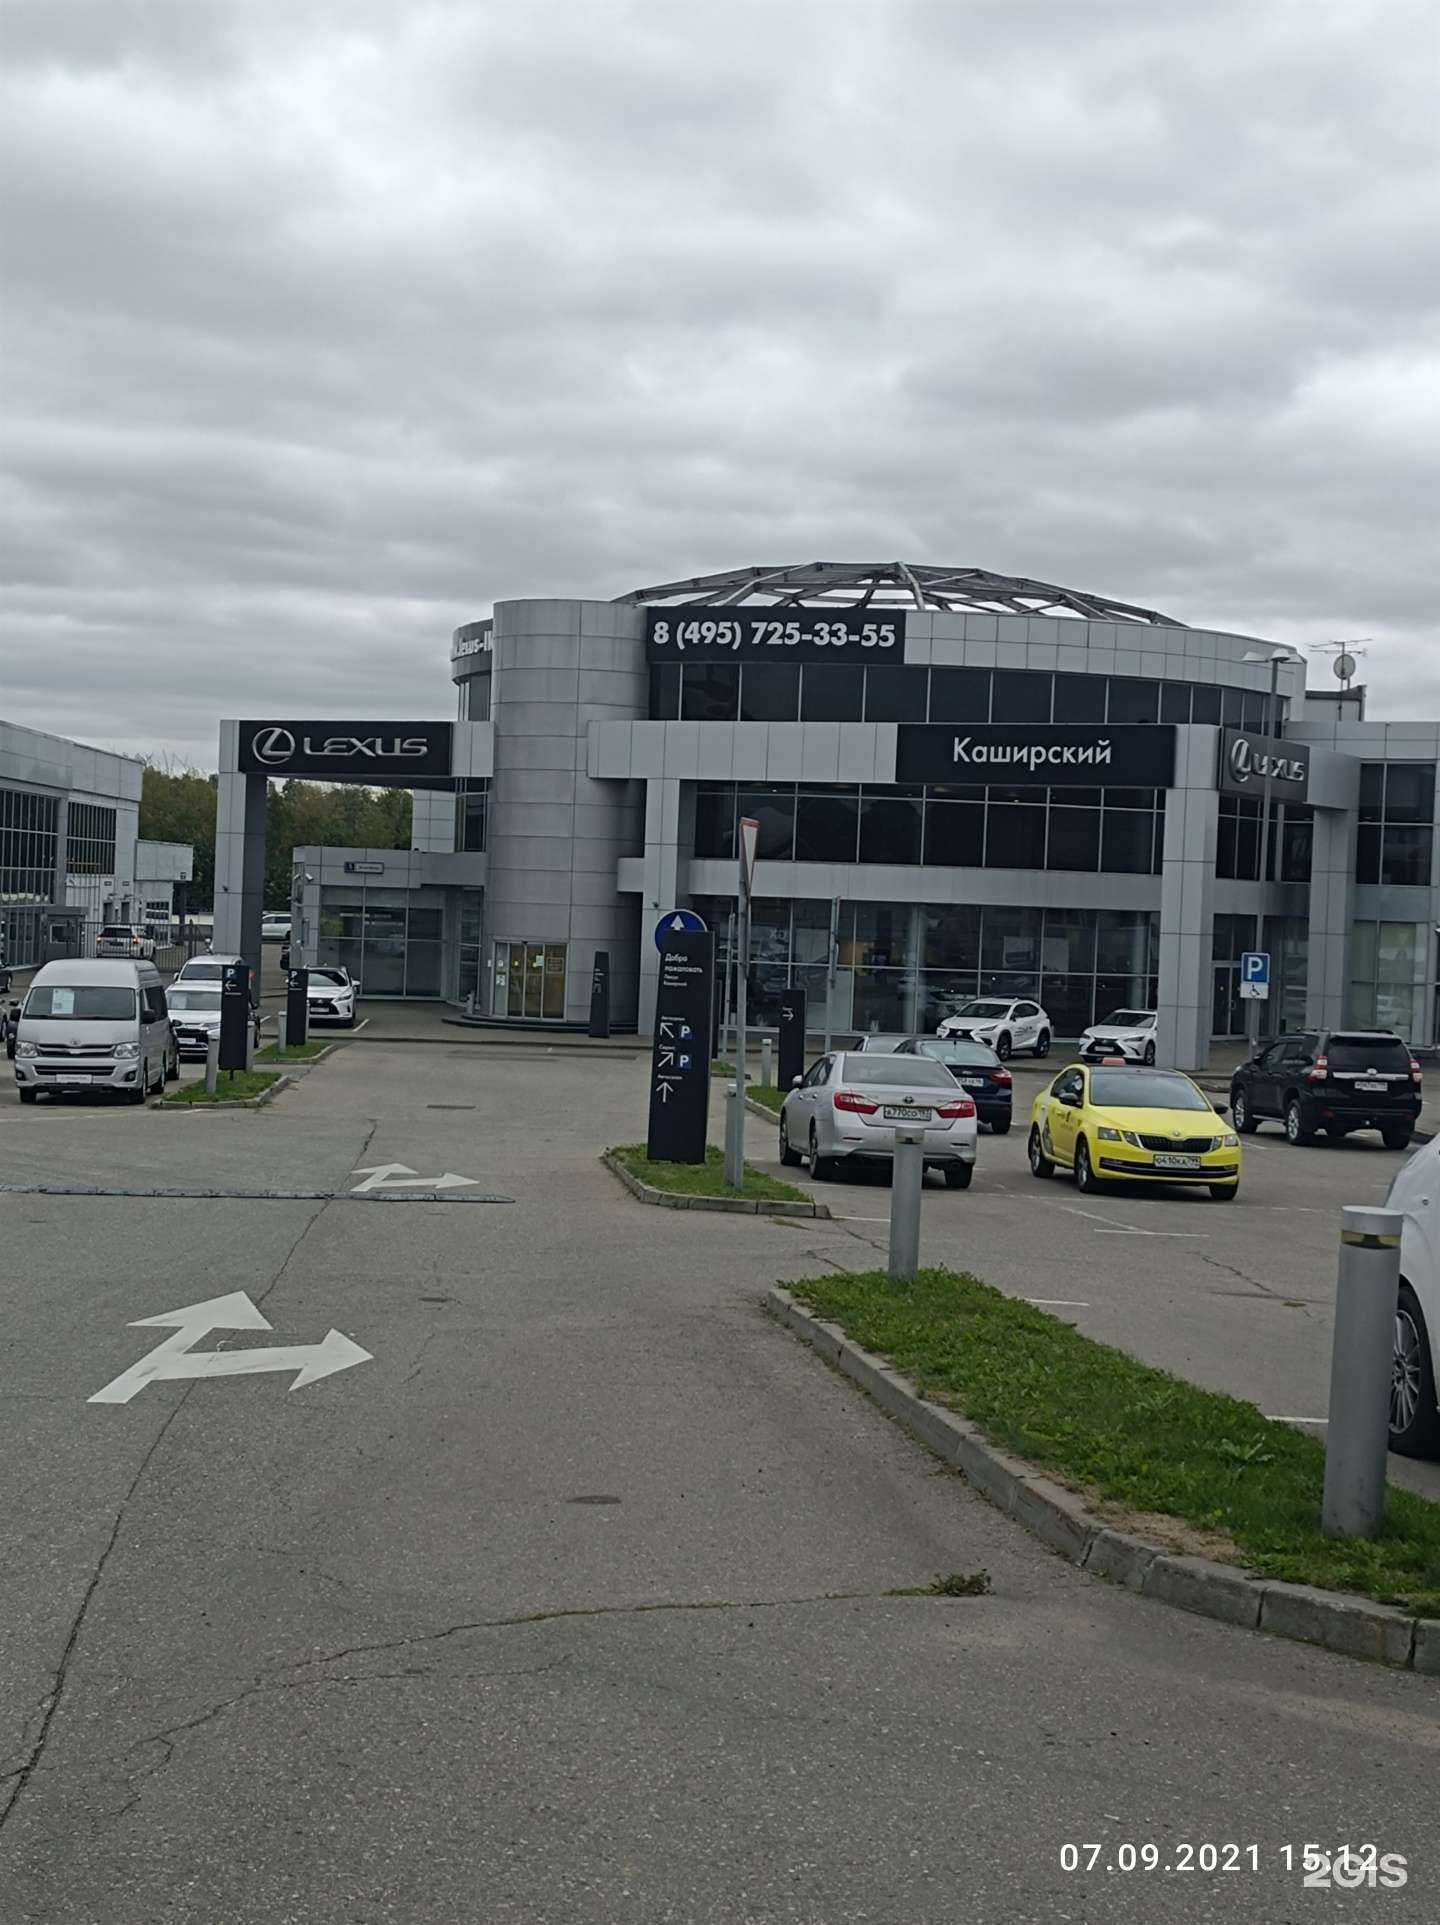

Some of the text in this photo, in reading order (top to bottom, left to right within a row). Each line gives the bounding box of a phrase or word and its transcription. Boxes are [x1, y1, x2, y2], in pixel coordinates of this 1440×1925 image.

[653, 621, 896, 650] 8 (495) 725-33-55
[303, 736, 429, 757] LEXUS
[953, 736, 1112, 771] Каширский
